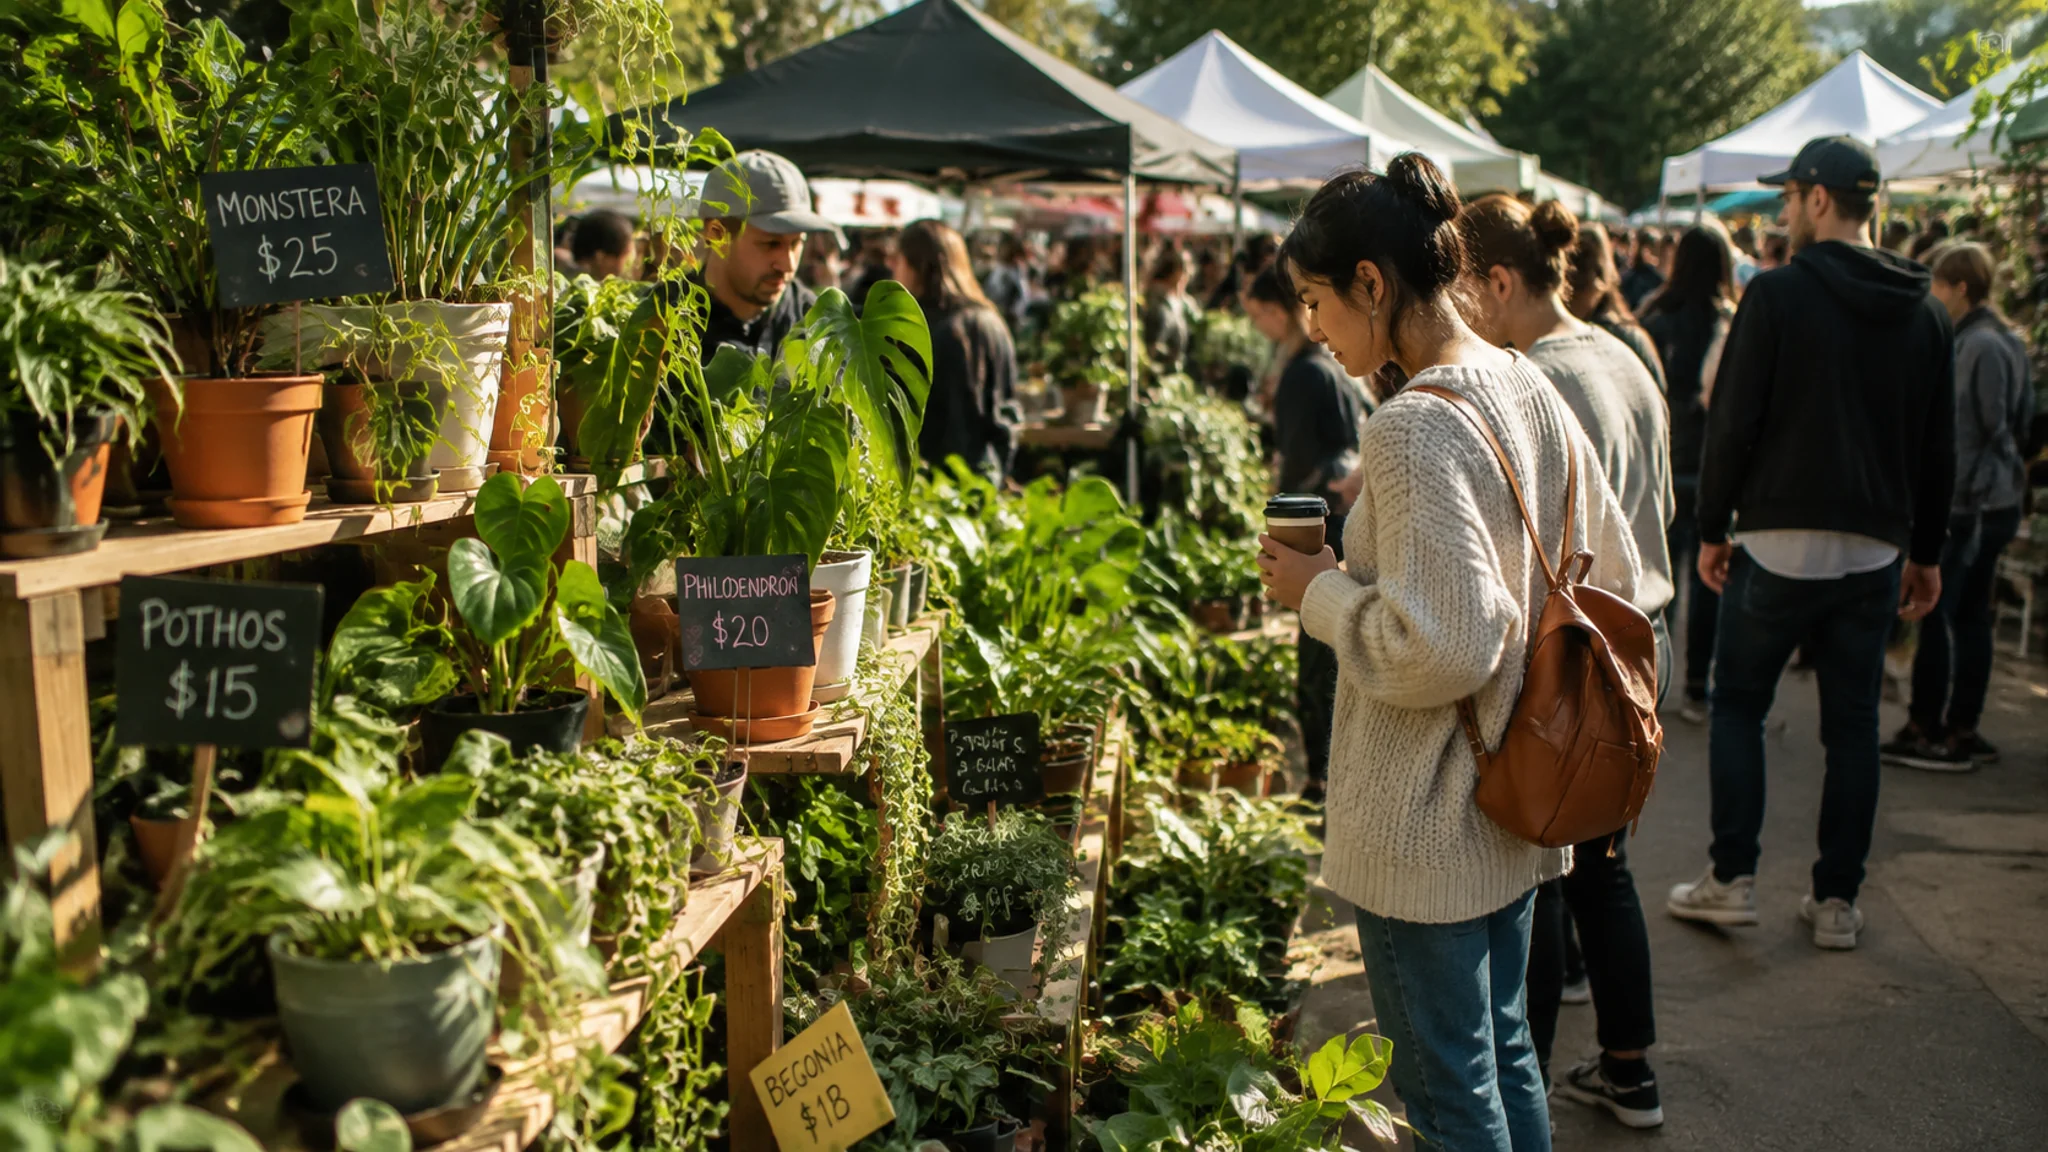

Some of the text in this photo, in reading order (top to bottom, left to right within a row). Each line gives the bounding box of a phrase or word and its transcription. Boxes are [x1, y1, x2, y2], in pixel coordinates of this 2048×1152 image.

[216, 185, 367, 227] MONSTERA
[258, 232, 338, 284] $25
[139, 597, 287, 652] POTHOS
[711, 610, 770, 650] $20
[164, 658, 258, 720] $15
[764, 1031, 854, 1108] BEGONIA
